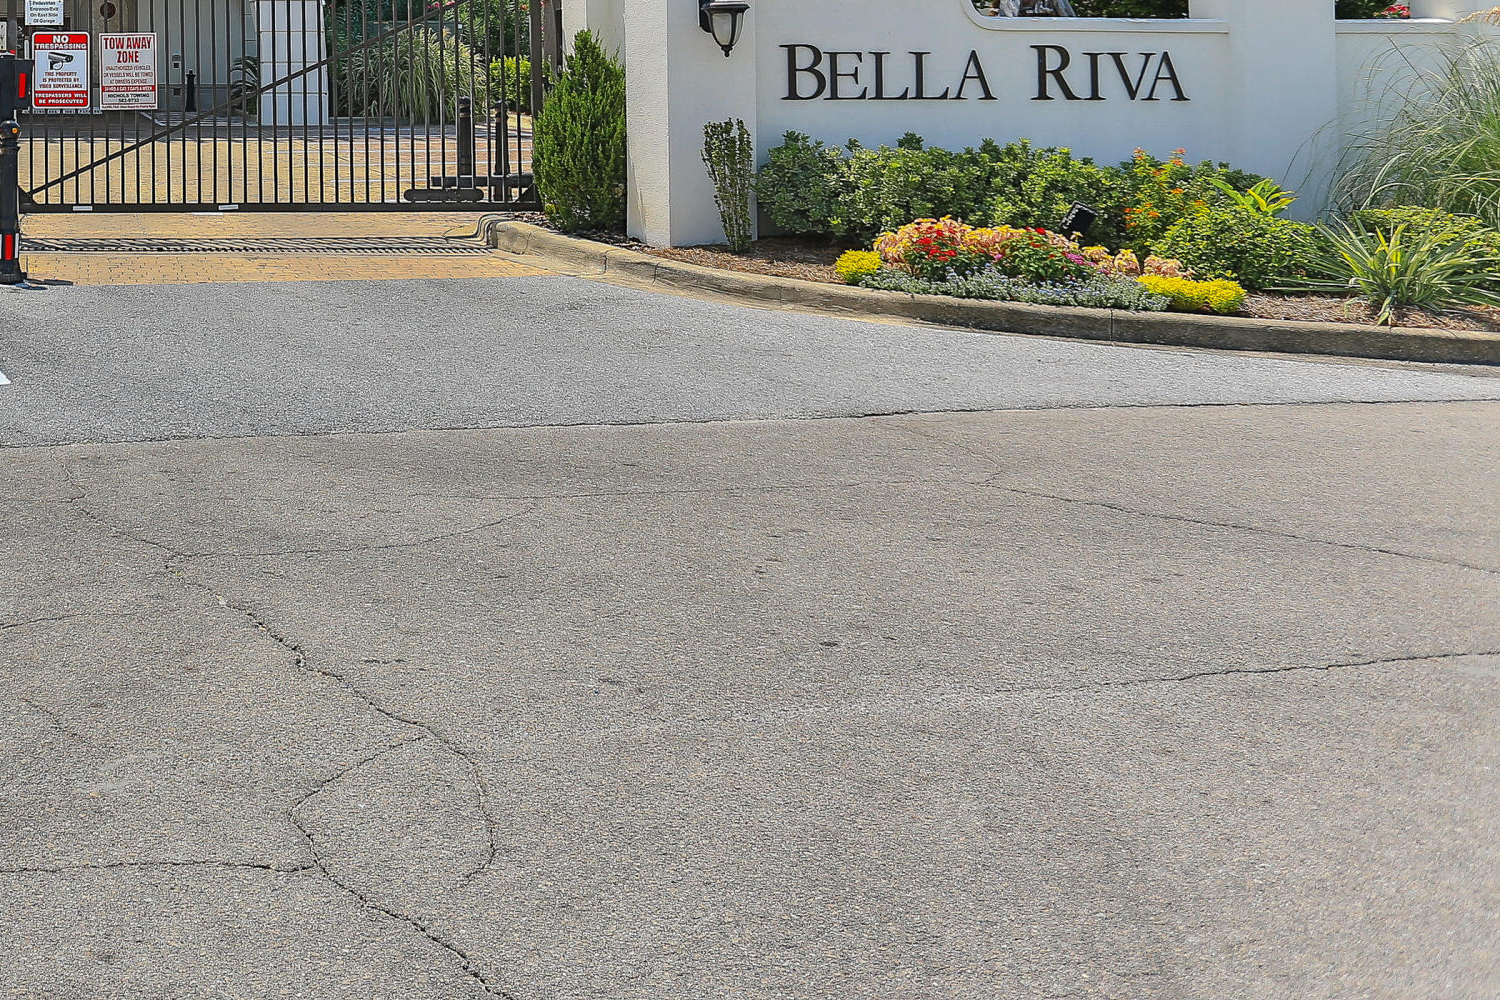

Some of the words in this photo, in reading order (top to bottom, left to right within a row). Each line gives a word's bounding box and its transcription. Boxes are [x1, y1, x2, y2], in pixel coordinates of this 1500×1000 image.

[52, 35, 69, 43] NO
[103, 37, 124, 49] TOW
[126, 37, 152, 49] AWAY
[116, 50, 139, 63] ZONE
[779, 44, 998, 101] BELLA
[1030, 44, 1192, 101] RIVA
